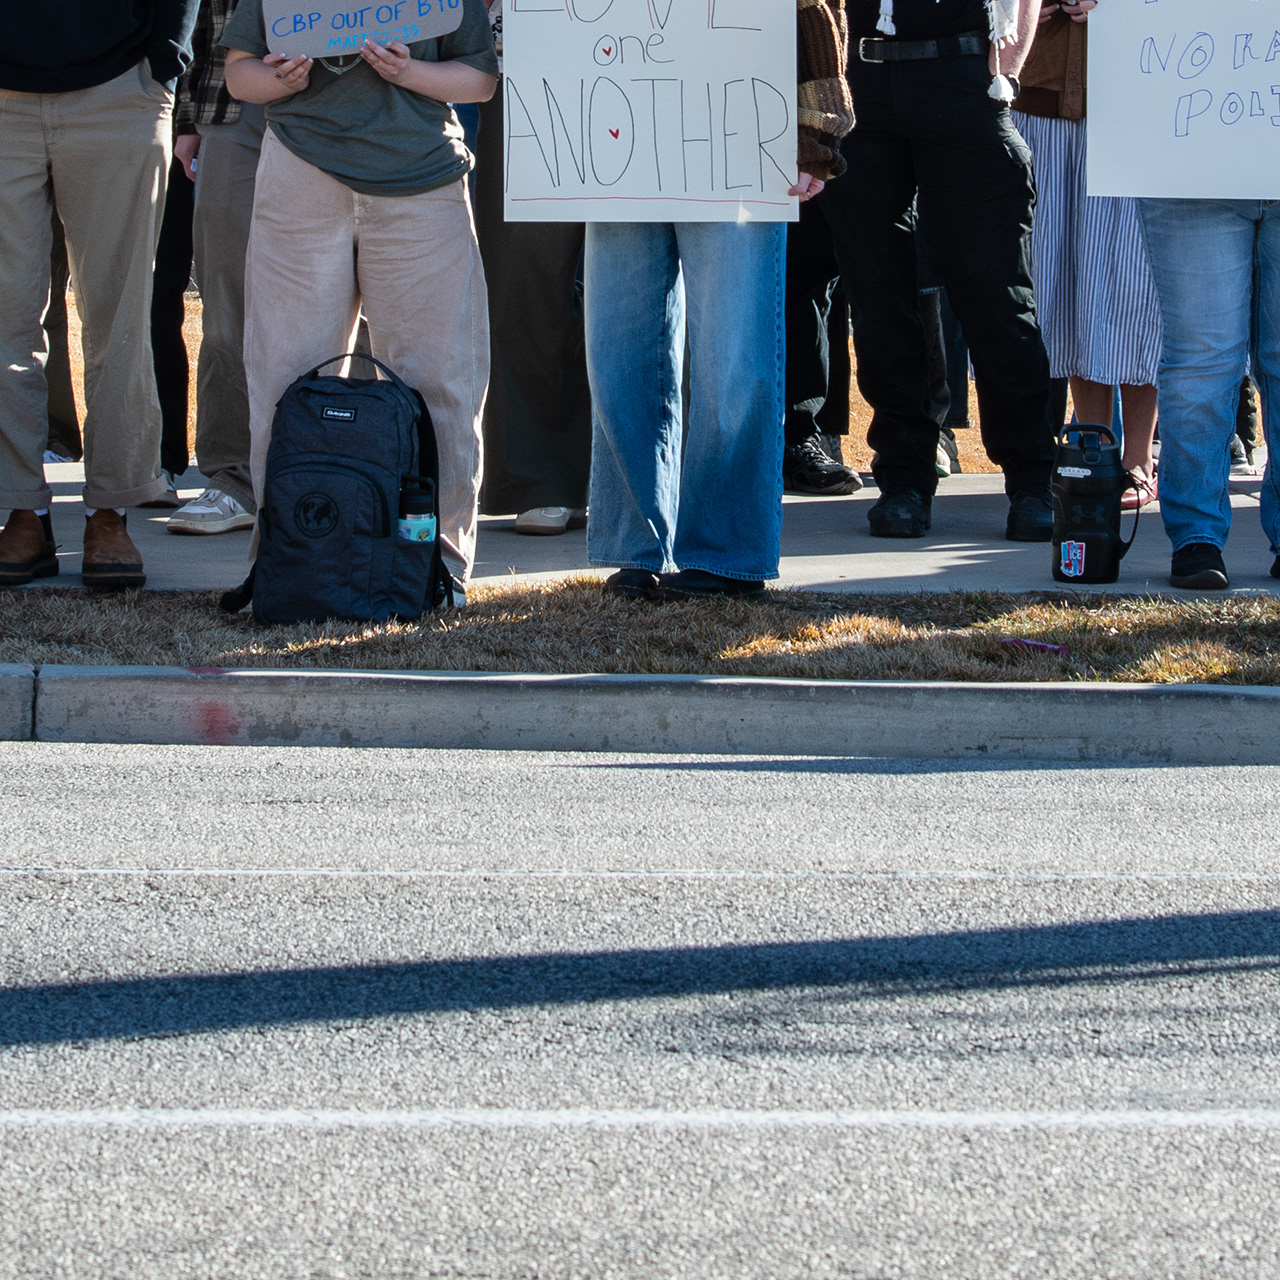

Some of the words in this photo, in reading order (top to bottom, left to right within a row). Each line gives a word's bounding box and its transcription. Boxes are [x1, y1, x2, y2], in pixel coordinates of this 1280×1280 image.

[272, 12, 322, 37] CBP
[331, 7, 371, 29] OUT
[376, 0, 407, 23] OF
[327, 33, 370, 50] MATT
[593, 33, 675, 67] one
[1139, 31, 1215, 81] NO
[505, 76, 796, 193] ANOTHER
